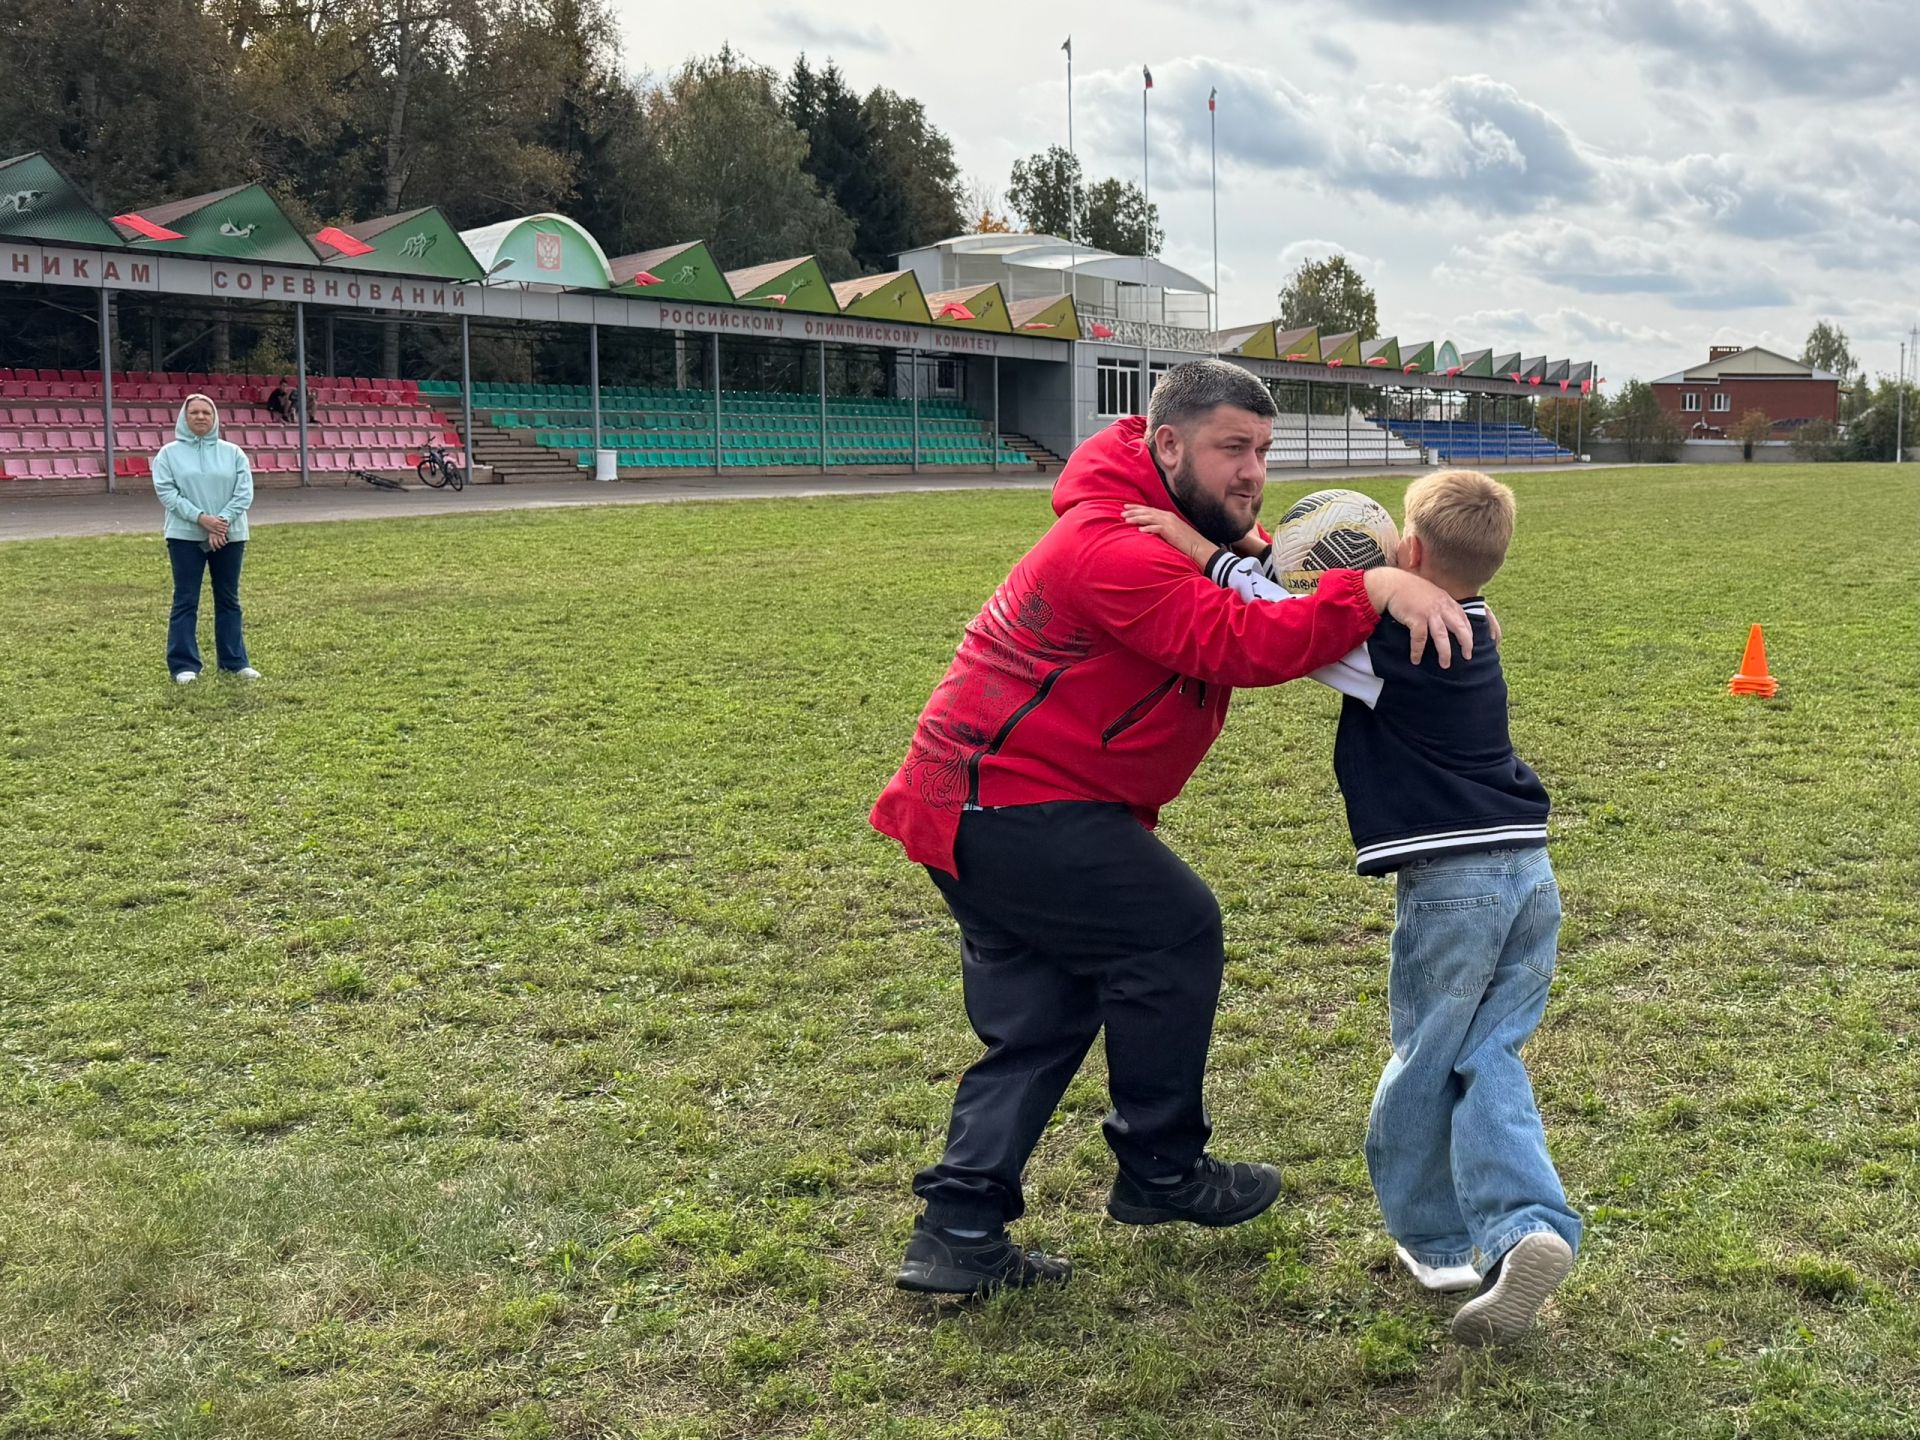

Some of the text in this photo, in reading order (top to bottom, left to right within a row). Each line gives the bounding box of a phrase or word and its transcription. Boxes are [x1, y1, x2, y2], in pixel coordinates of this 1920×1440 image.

[213, 270, 466, 307] СОРЕВНОВАНИЙ
[660, 308, 1000, 352] РОССИЙСКОМУ ОЛИМПИЙСКОМУ КОМИТЕТУ
[1288, 578, 1320, 590] PORT
